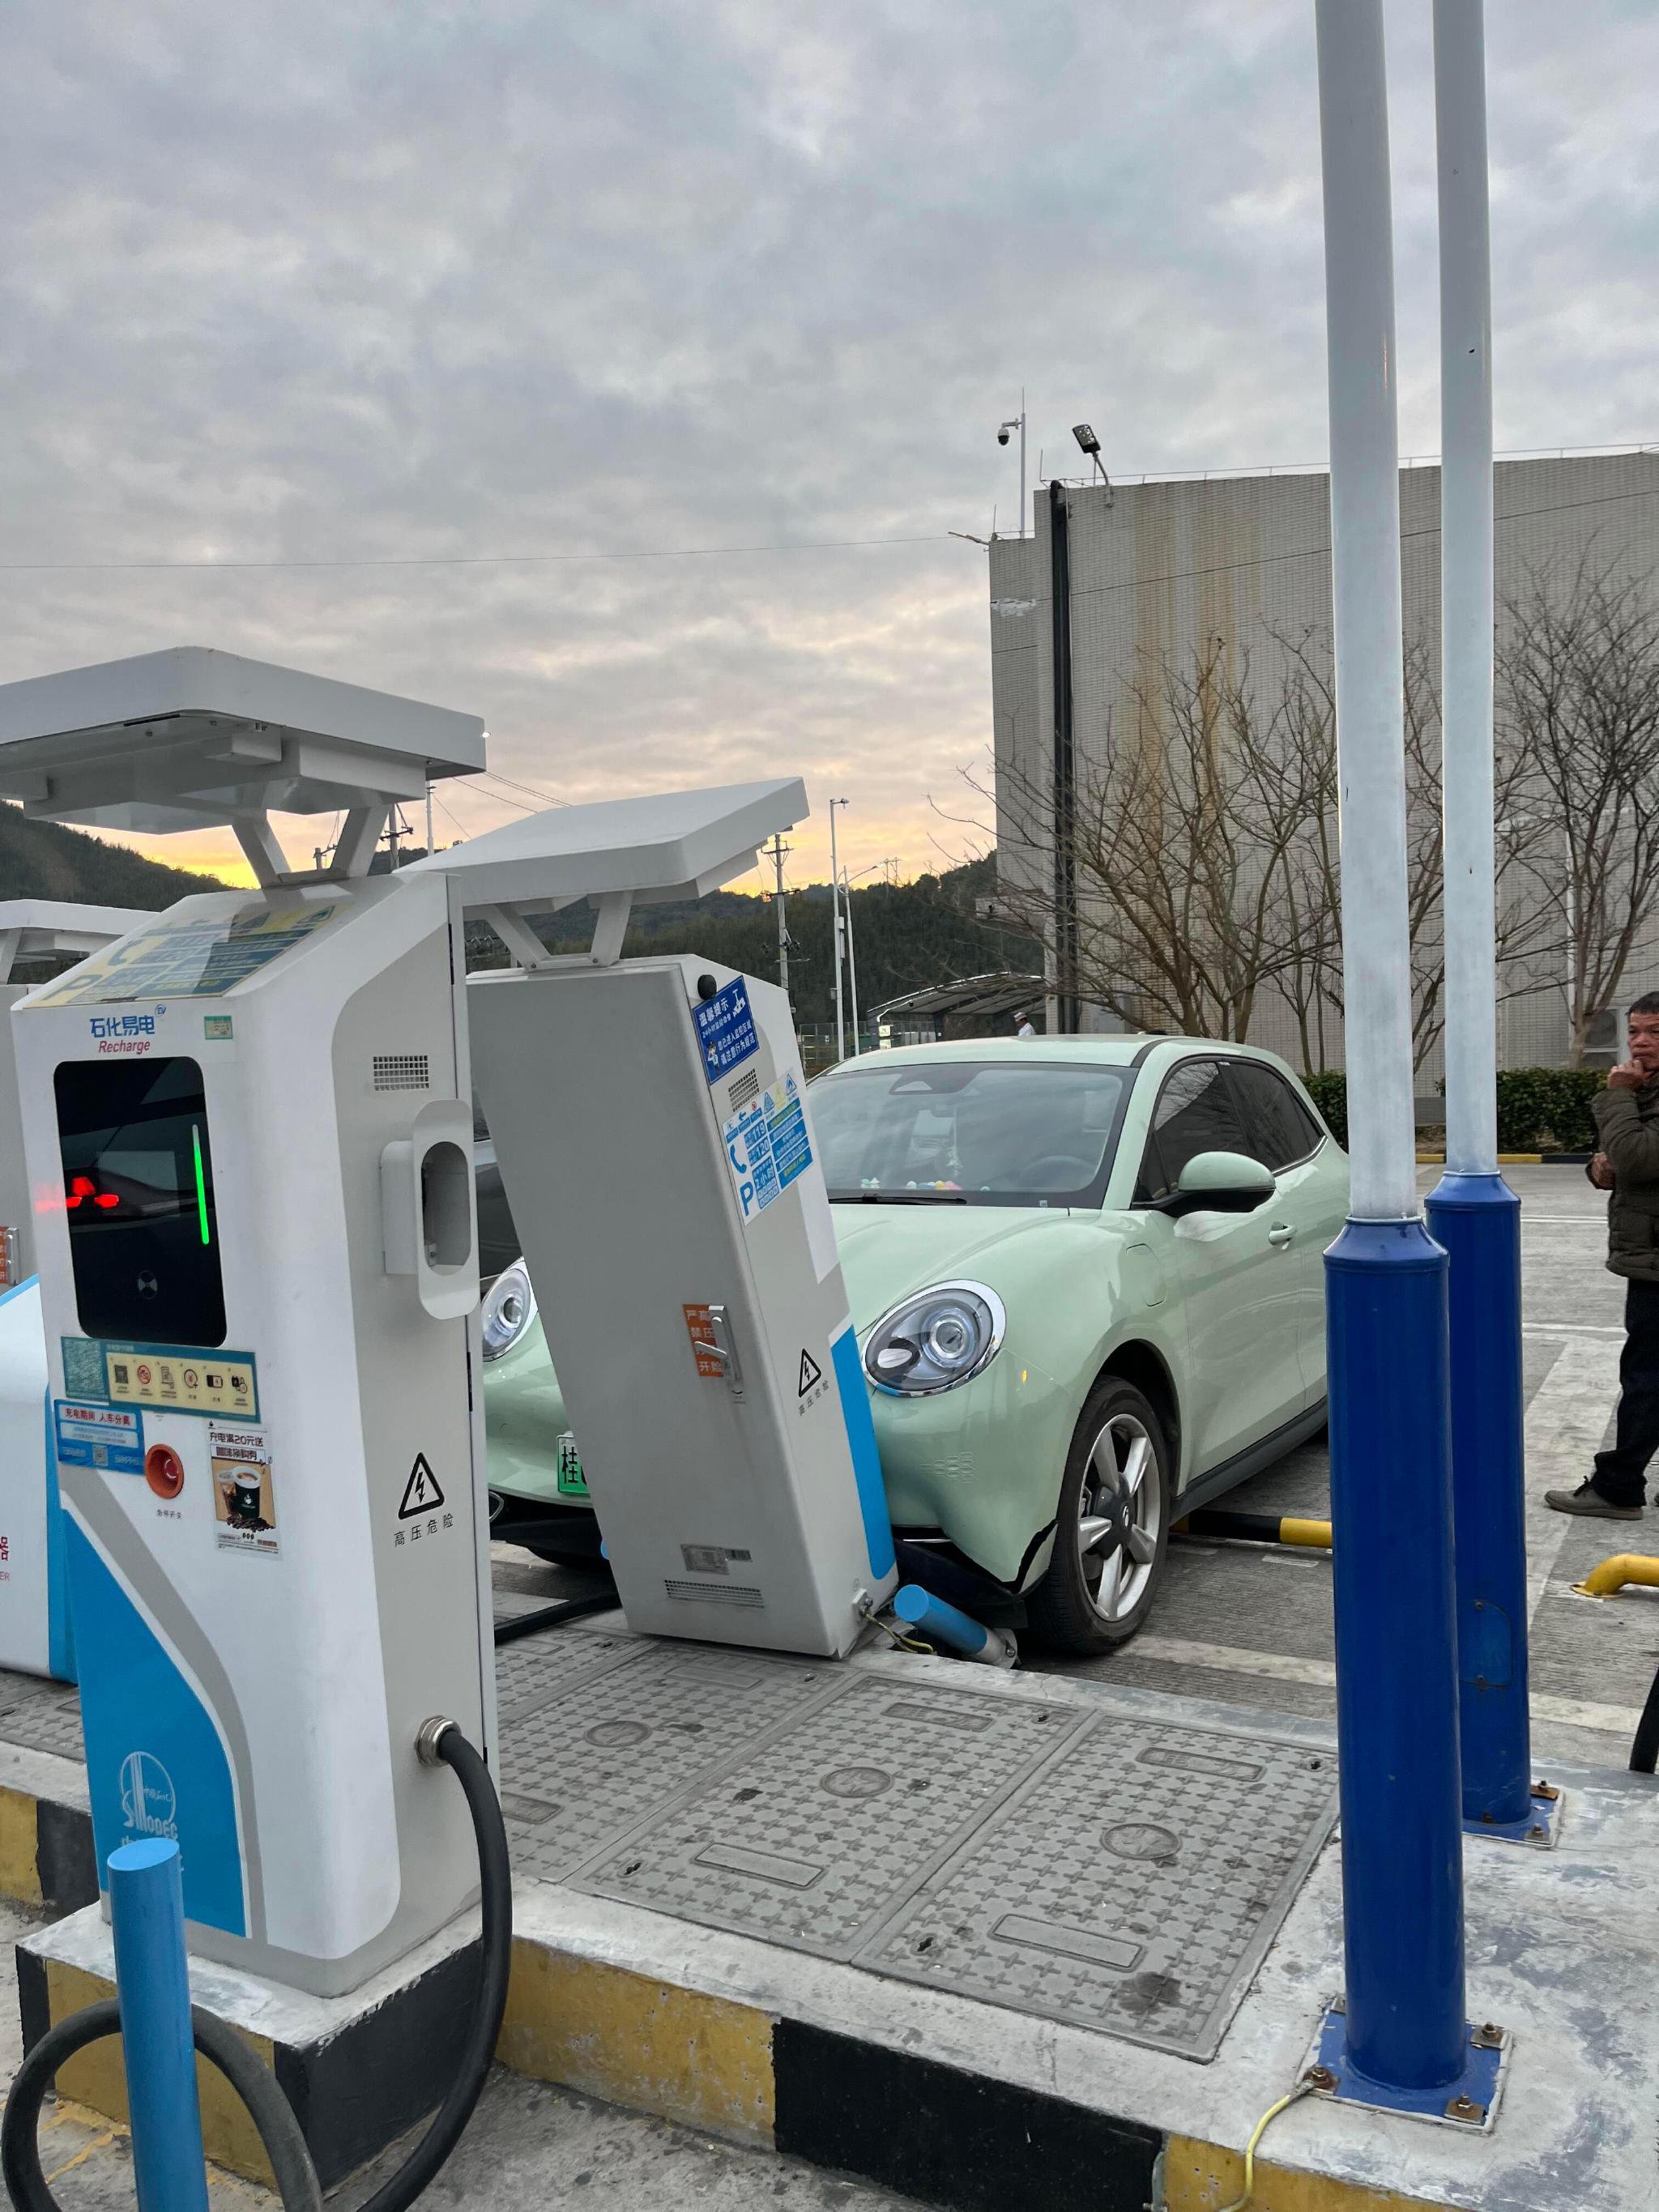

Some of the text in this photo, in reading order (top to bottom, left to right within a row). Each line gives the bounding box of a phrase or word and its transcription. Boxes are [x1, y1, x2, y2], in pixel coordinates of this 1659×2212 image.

[699, 997, 729, 1027] 温馨提示
[90, 1015, 156, 1038] 石化易电
[99, 1040, 151, 1055] Recharge
[753, 1122, 766, 1140] 119
[756, 1139, 770, 1157] 120
[394, 1513, 454, 1548] 高压危险
